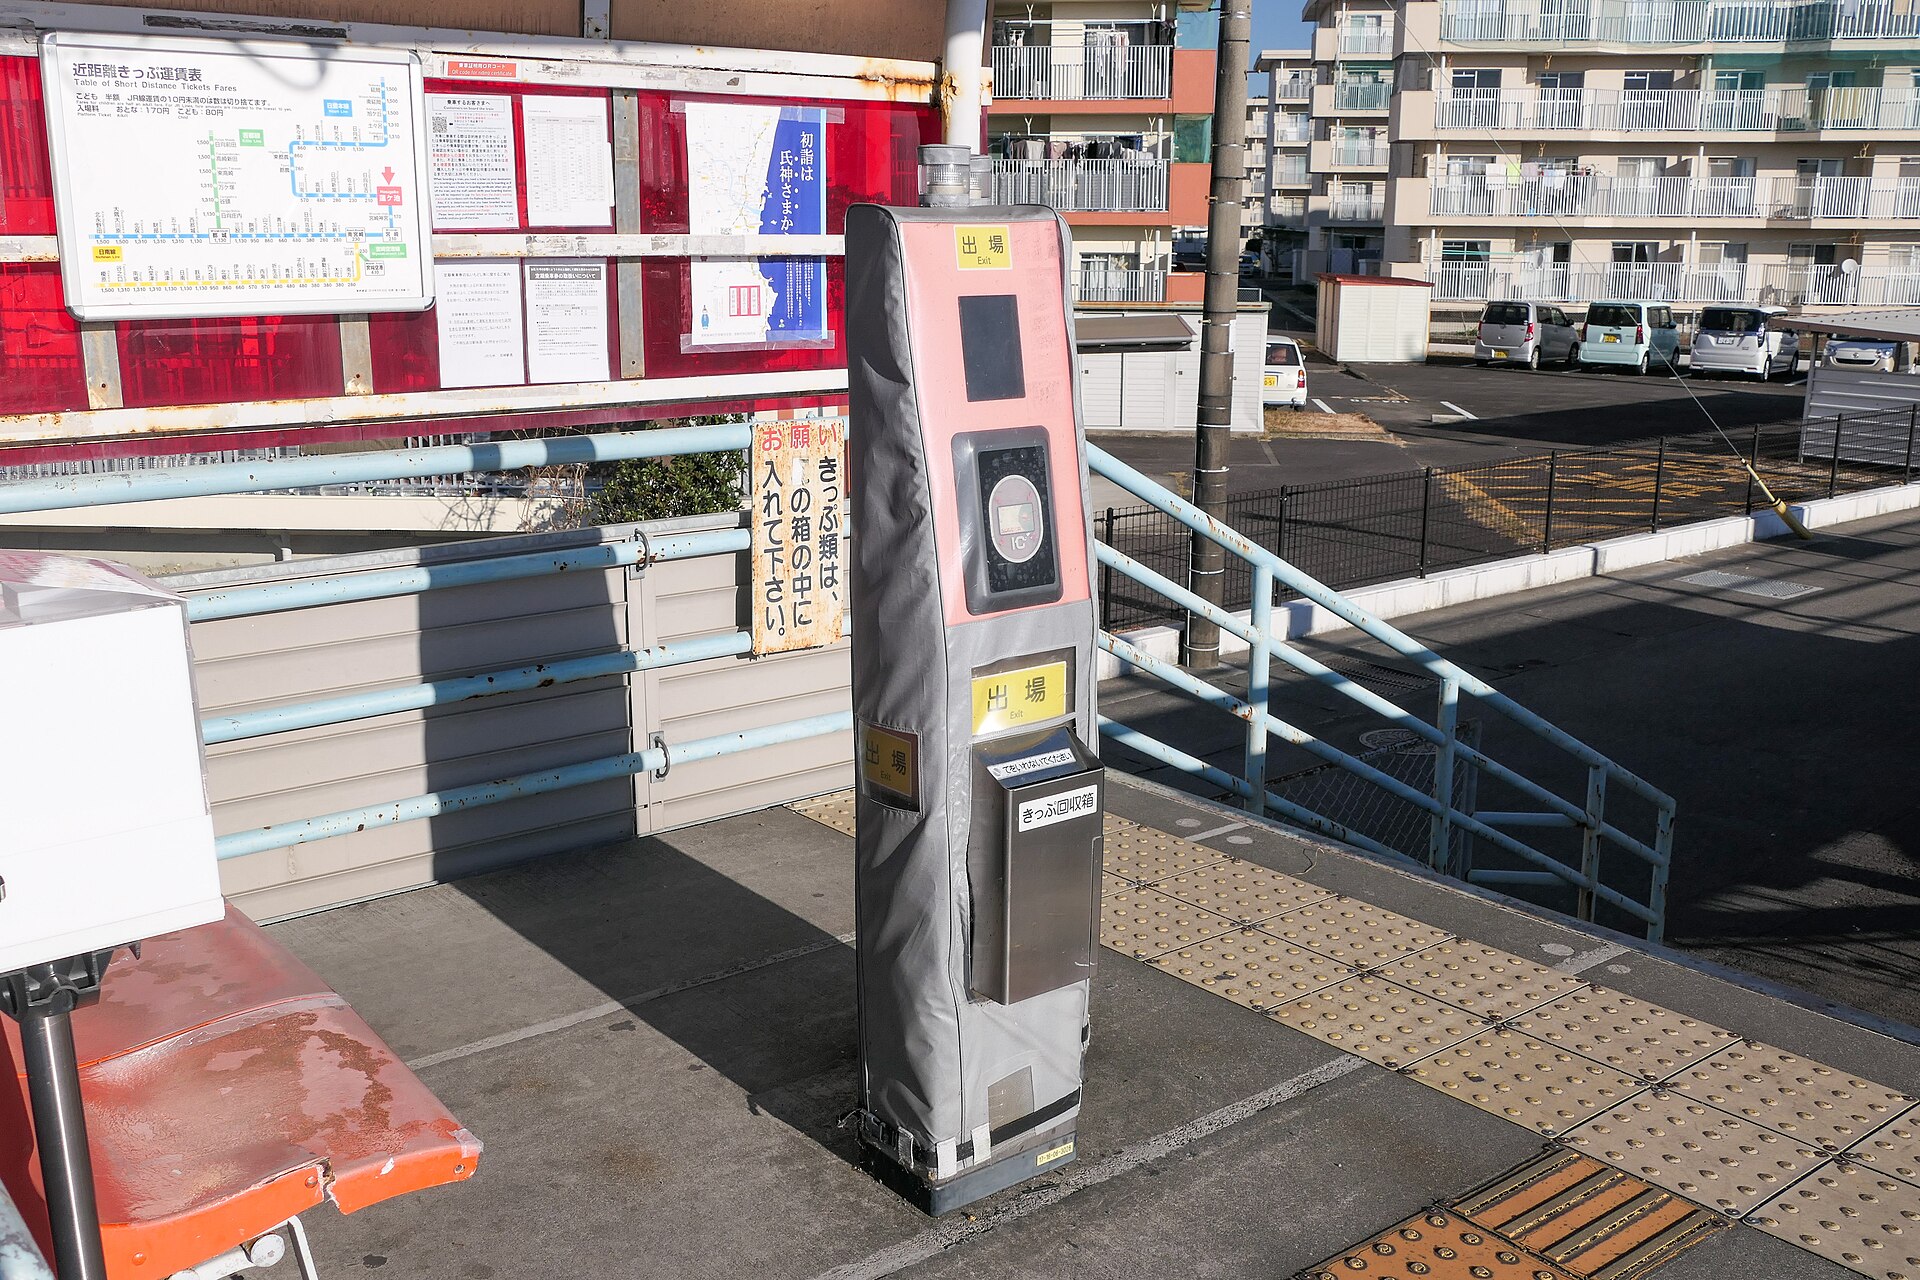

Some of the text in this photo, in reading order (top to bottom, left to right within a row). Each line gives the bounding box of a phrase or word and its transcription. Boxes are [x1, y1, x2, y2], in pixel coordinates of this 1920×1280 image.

[72, 64, 202, 82] 近距離きっぷ運賃表
[74, 78, 98, 86] Table
[181, 83, 210, 91] Tickets
[800, 131, 814, 181] 初詣は
[780, 150, 794, 236] 氏神さまか
[962, 235, 1004, 254] 出場
[977, 256, 991, 265] Exit
[761, 423, 837, 452] お願い
[818, 456, 839, 601] きっぷ類は、
[1011, 536, 1025, 551] IC
[763, 460, 785, 636] 入れて下さい。
[790, 461, 812, 628] の箱の中に
[988, 676, 1046, 712] 出場
[1010, 709, 1024, 719] Exit
[866, 740, 906, 776] 出場
[1002, 752, 1072, 774] てをいれないでください
[1022, 792, 1094, 823] きっぷ回収箱
